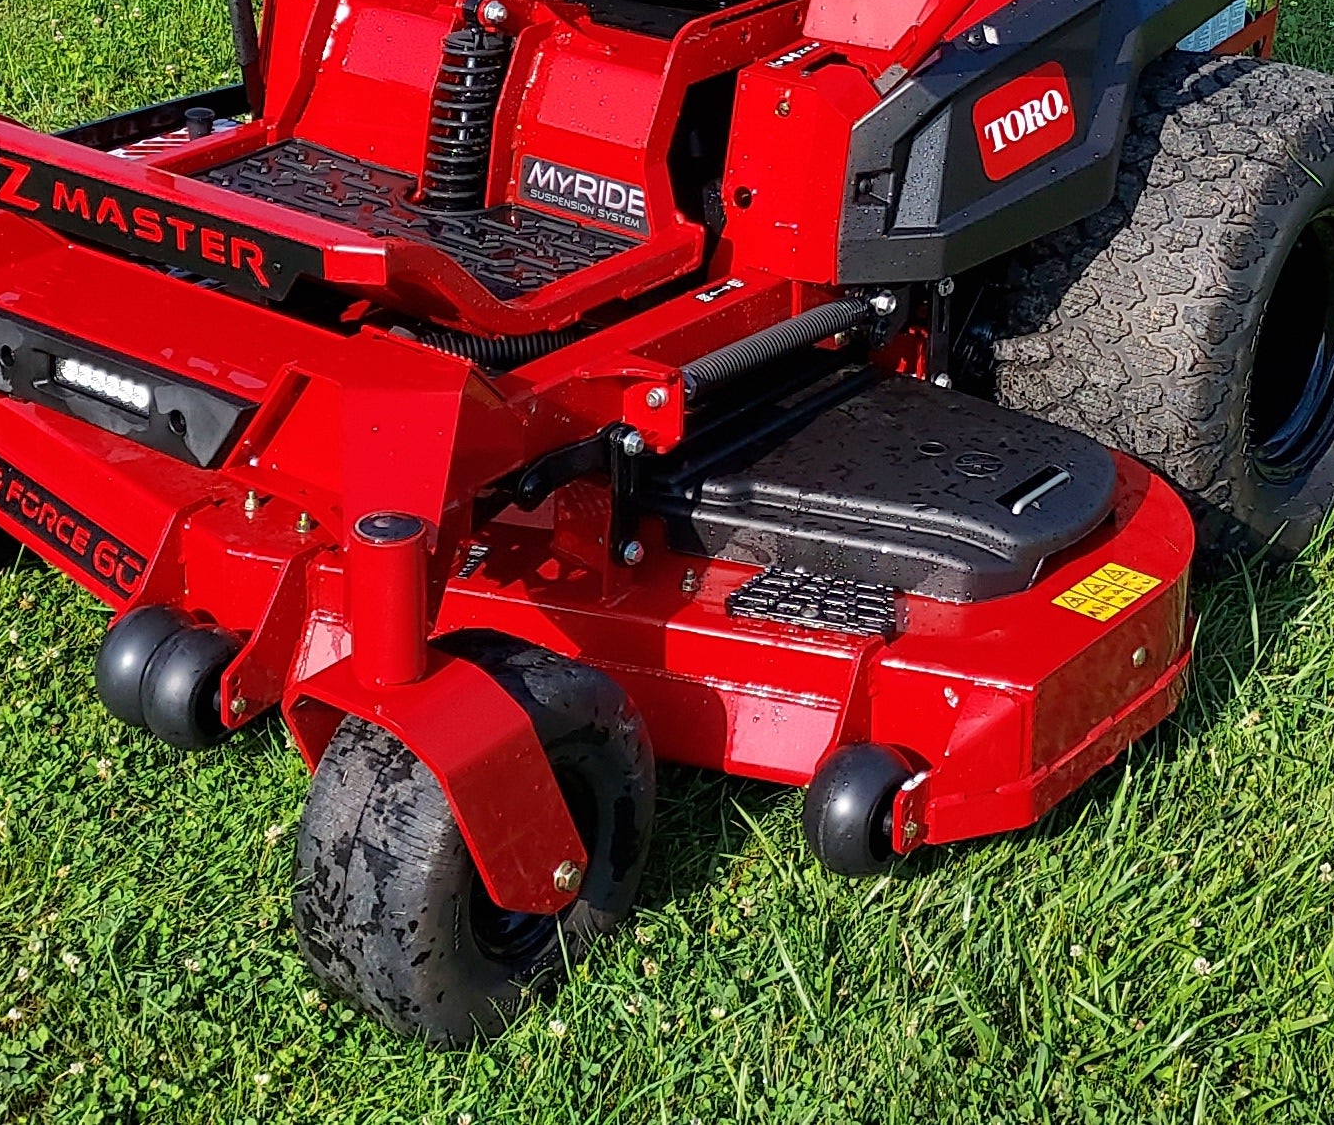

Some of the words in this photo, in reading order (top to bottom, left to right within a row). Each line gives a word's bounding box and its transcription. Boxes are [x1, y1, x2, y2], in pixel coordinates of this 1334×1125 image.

[984, 89, 1064, 153] TORO
[52, 181, 270, 288] MASTER
[530, 188, 595, 215] SUSPENSION
[597, 208, 640, 229] SYSTEM
[6, 480, 91, 556] FORCE
